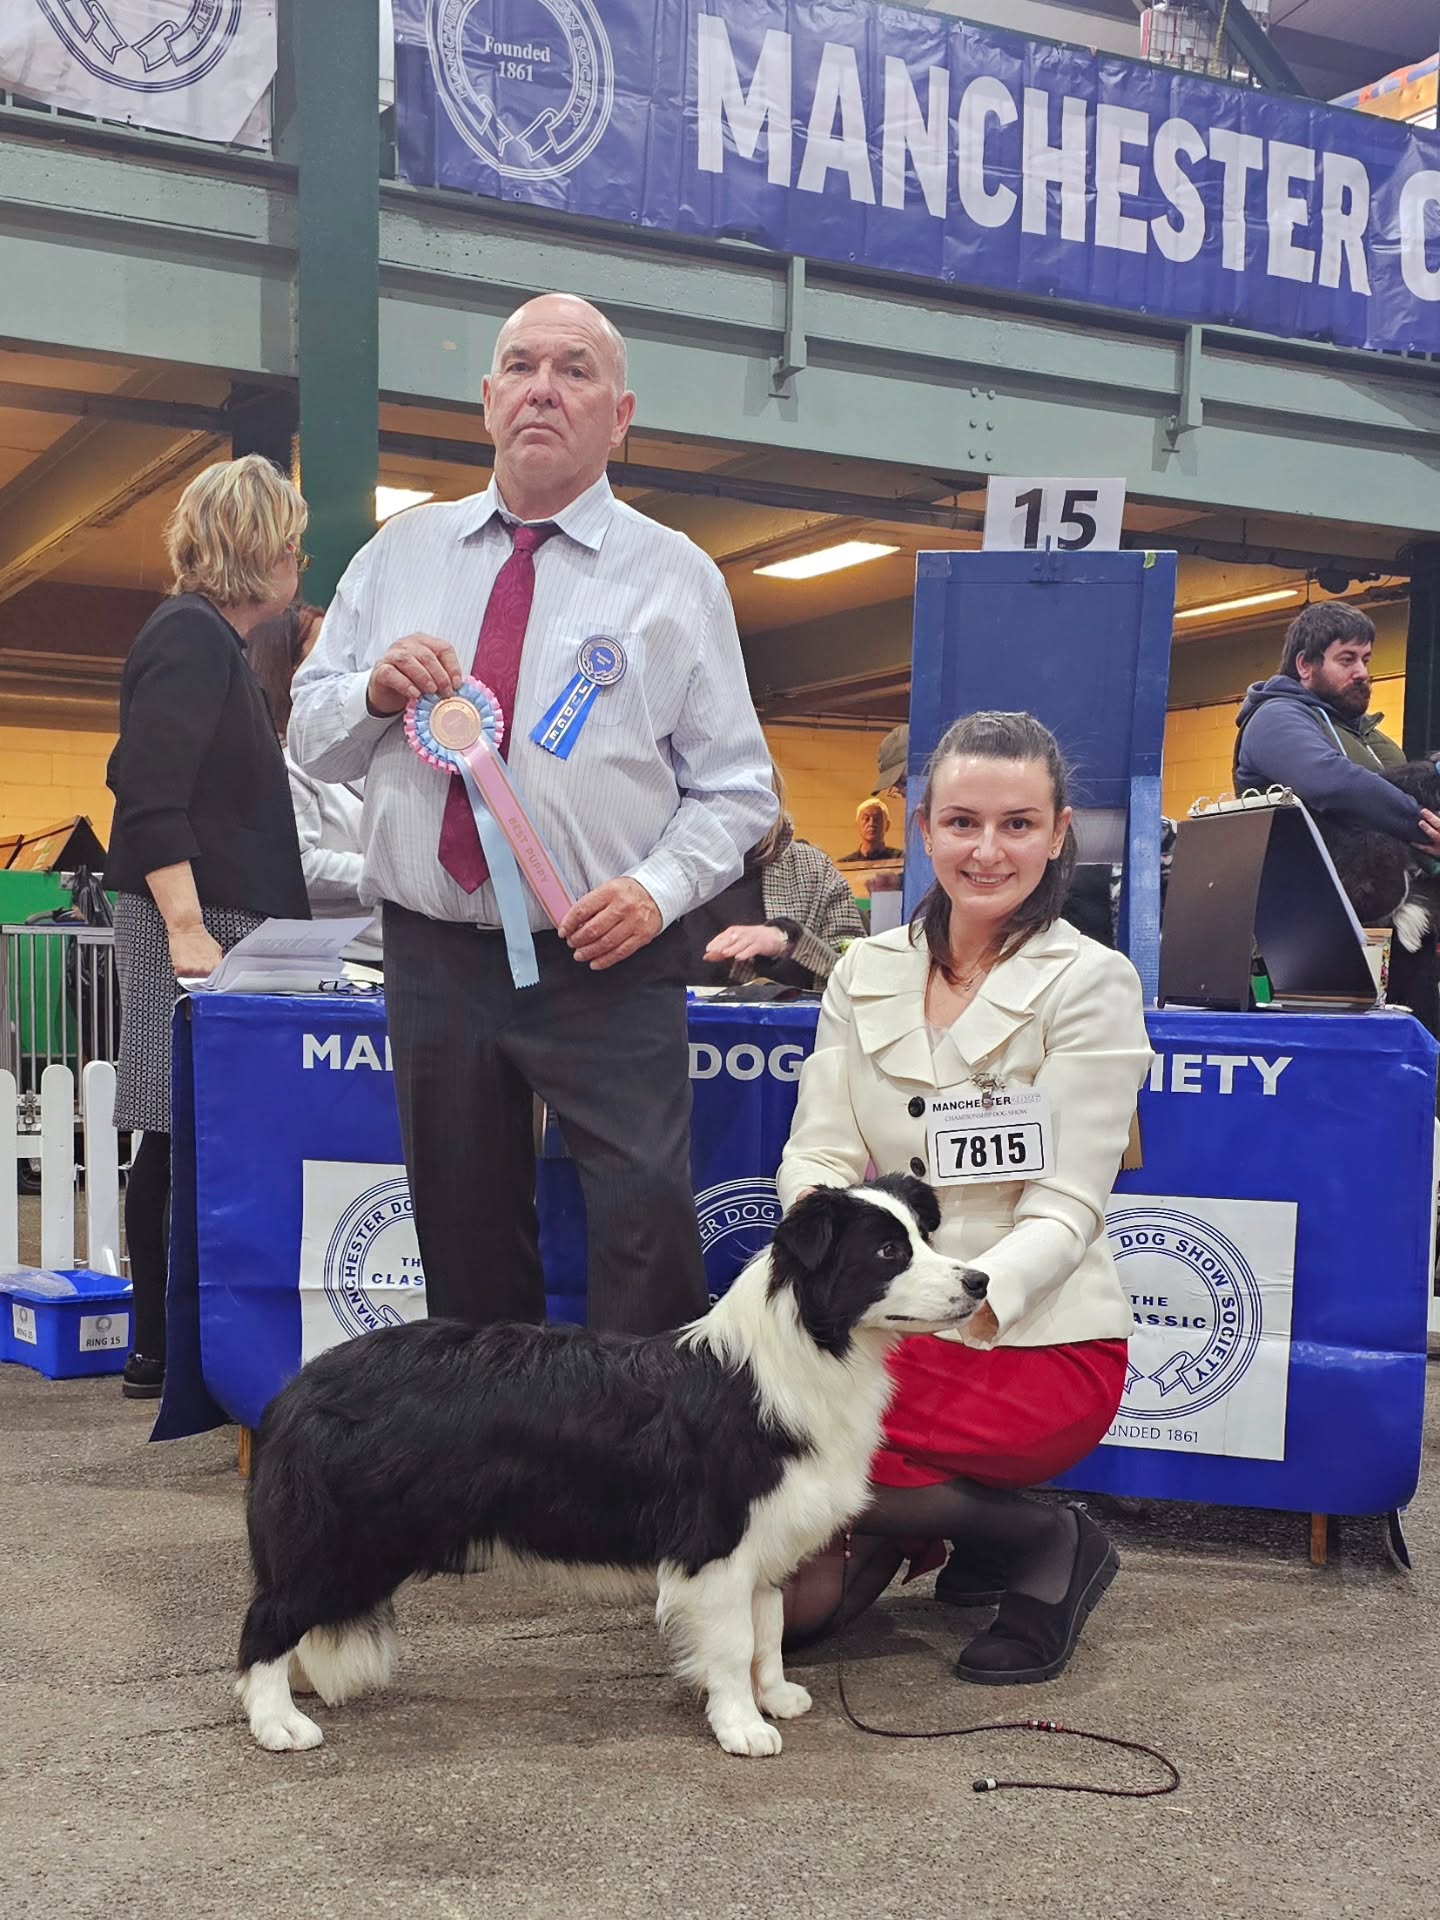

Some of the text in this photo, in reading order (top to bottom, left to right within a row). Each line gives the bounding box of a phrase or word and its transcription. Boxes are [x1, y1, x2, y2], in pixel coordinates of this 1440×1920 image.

[484, 35, 551, 63] Founded
[498, 61, 534, 82] 1861
[697, 14, 1372, 297] MANCHESTER
[1014, 488, 1099, 550] 15
[508, 816, 549, 882] BEST PUPPY
[302, 1033, 394, 1072] MA
[687, 1042, 804, 1082] DOG
[932, 1096, 1011, 1112] MANCHETER
[993, 1109, 1009, 1118] DOG
[1010, 1107, 1028, 1117] SHOW
[950, 1132, 1026, 1169] 7815
[724, 1204, 775, 1224] DOG
[344, 1210, 385, 1330] MANCHESTER
[1119, 1231, 1236, 1382] DOG SHOW SOCIETY
[1130, 1294, 1169, 1307] THE
[86, 1336, 121, 1348] RING 15
[1167, 1428, 1199, 1443] 1861
